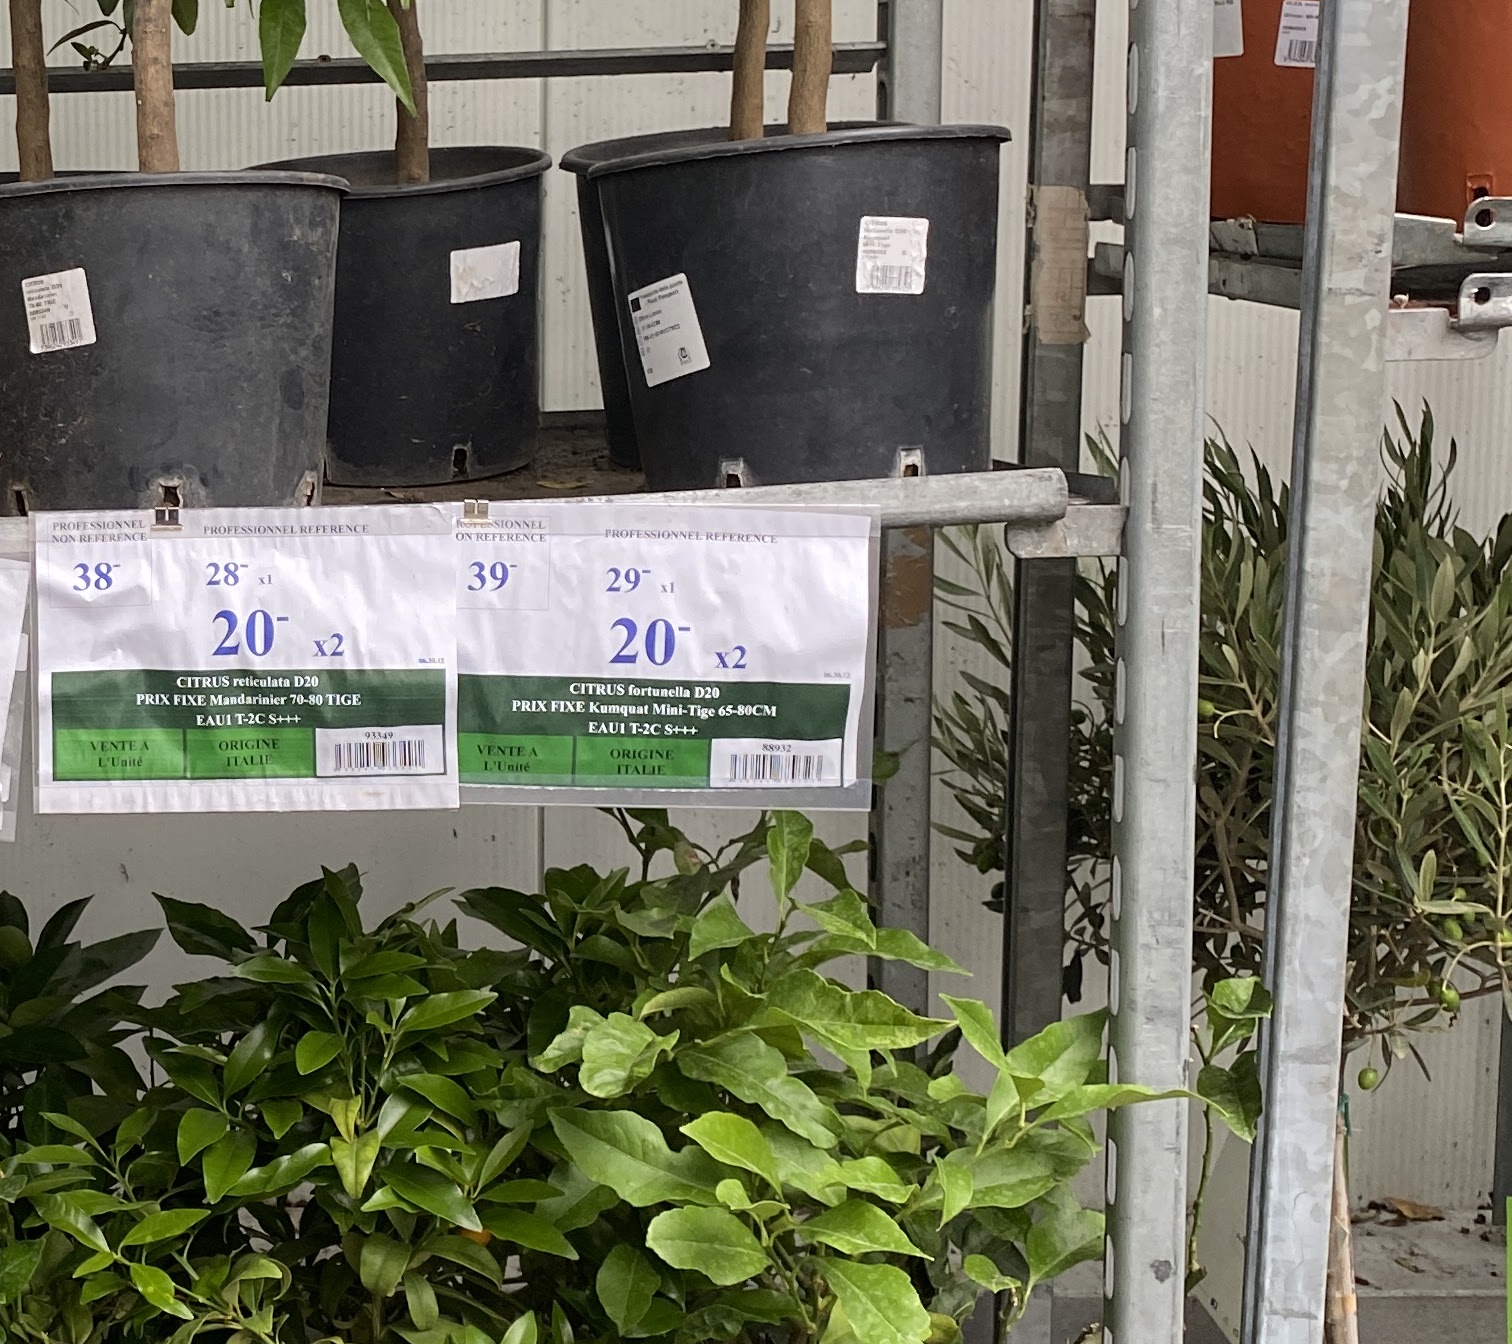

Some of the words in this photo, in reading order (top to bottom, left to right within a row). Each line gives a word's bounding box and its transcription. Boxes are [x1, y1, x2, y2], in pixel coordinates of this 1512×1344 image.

[52, 520, 146, 532] PROFESSIONNEL
[203, 524, 298, 535] PROFESSIONNEL
[299, 524, 369, 535] REFERENCE
[51, 533, 75, 543] NON
[76, 532, 148, 543] REFERENCE
[455, 532, 473, 542] ON
[475, 532, 547, 543] REFERENCE
[604, 529, 703, 542] PROFESSIONNEL
[705, 531, 778, 544] REFERENCE
[258, 574, 273, 585] x1
[660, 582, 675, 594] x1
[313, 632, 345, 657] x2
[714, 644, 748, 669] x2
[176, 675, 230, 688] CITRUS
[232, 675, 291, 688] reticulata
[293, 675, 319, 688] D20
[568, 683, 625, 696] CITRUS
[627, 683, 691, 698] fortunella
[693, 686, 720, 699] D20
[135, 693, 171, 707] PRIX
[173, 693, 207, 707] FIXE
[209, 693, 287, 707] Mandarinier
[289, 693, 323, 707] 70-80
[324, 693, 362, 707] TIGE
[511, 699, 548, 712] PRIX
[550, 700, 586, 713] FIXE
[588, 701, 649, 716] Kumquat
[652, 703, 716, 718] Mini-Tige
[717, 704, 777, 718] 65-80CM
[234, 713, 267, 726] T-2C
[268, 713, 302, 726] S+++
[588, 722, 625, 734] EAU1
[628, 723, 662, 735] T-2C
[663, 723, 698, 736] S+++
[89, 740, 138, 752] VENTE
[139, 740, 150, 752] A
[218, 738, 280, 752] ORIGINE
[476, 744, 526, 757] VENTE
[527, 746, 538, 757] A
[761, 743, 792, 753] 88932
[225, 754, 274, 767] ITALIE
[609, 747, 675, 761] ORIGINE
[616, 763, 666, 777] ITALIE
